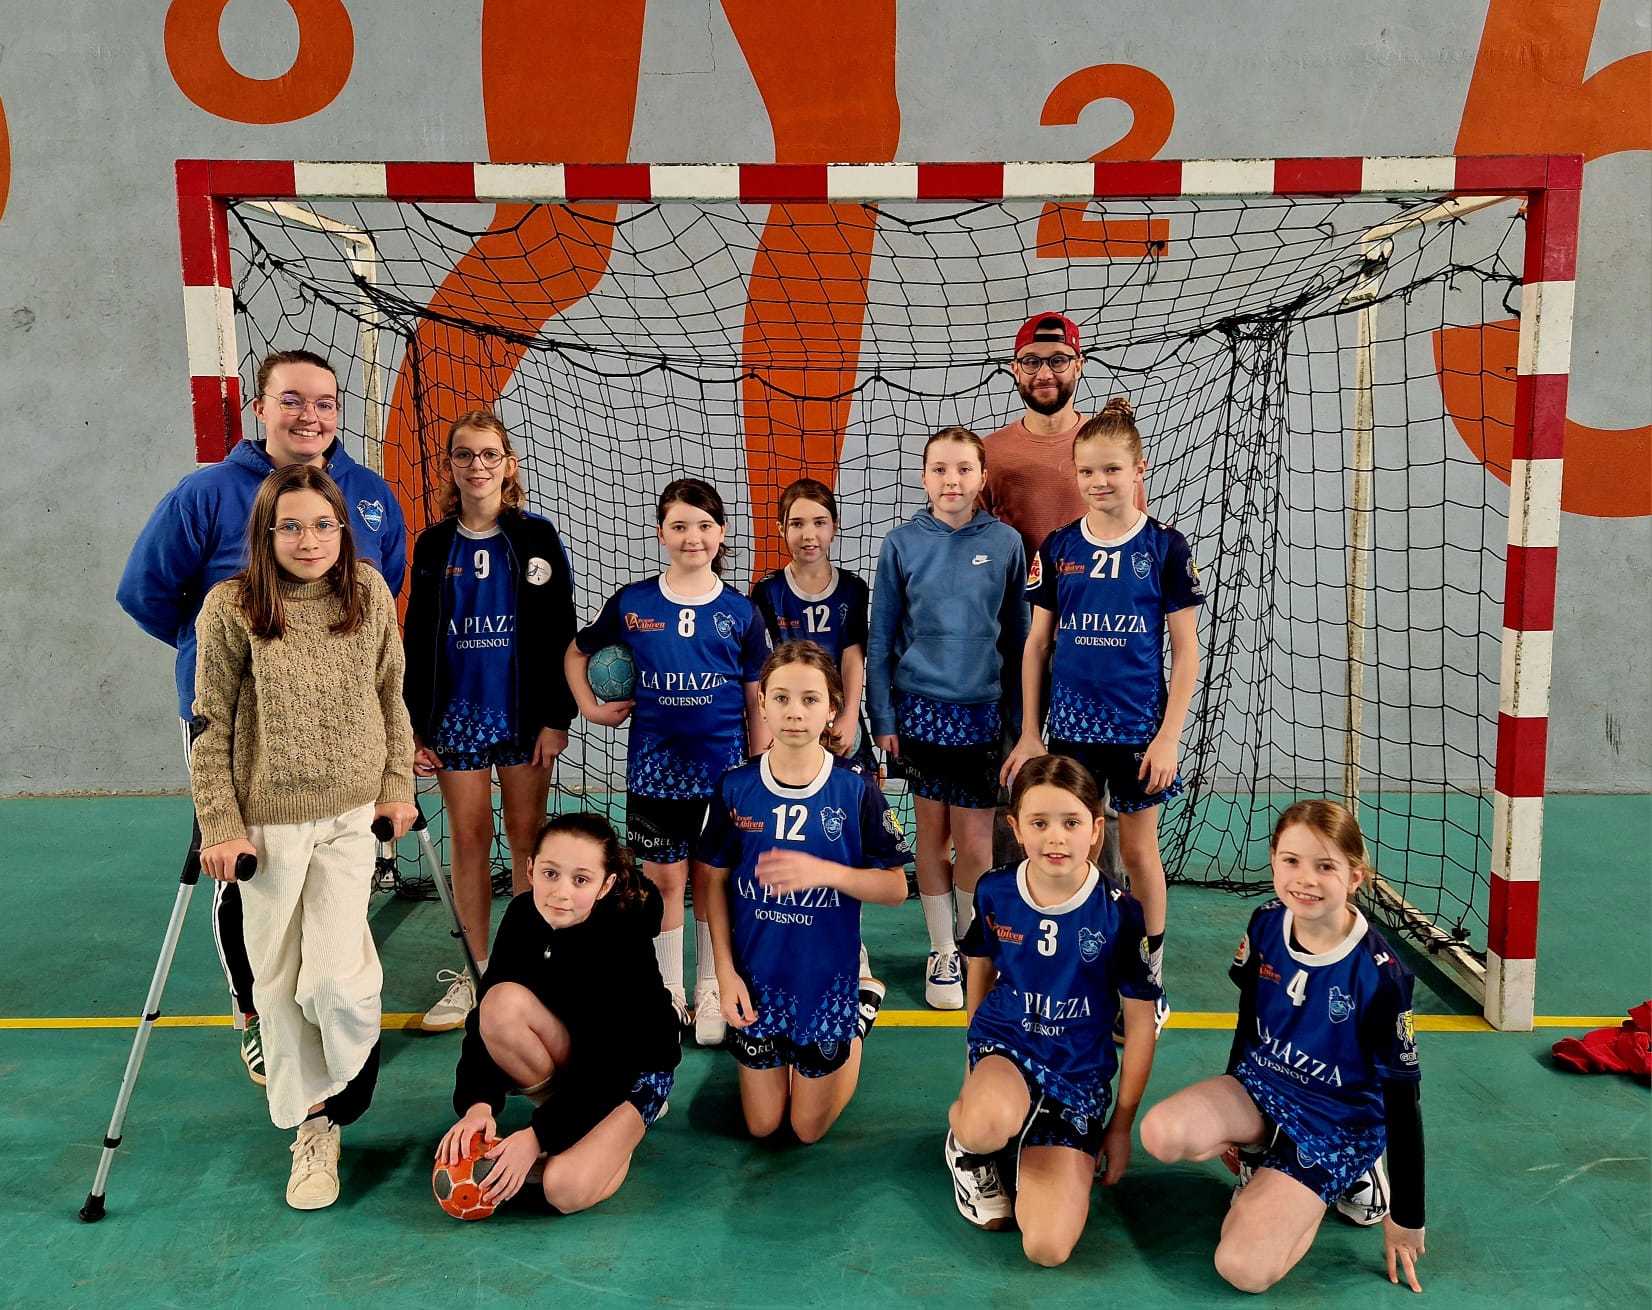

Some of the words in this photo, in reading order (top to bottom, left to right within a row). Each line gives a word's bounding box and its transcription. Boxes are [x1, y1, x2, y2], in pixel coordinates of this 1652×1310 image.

[1036, 63, 1175, 258] 2
[473, 549, 490, 579] 9
[1090, 549, 1121, 579] 21
[678, 608, 696, 638] 8
[802, 604, 832, 633] 12
[1059, 612, 1078, 630] LA
[1081, 613, 1148, 633] PIAZZA
[456, 637, 509, 650] GOUESNOU
[1074, 635, 1127, 647] GOUESNOU
[640, 670, 660, 690] LA
[658, 694, 713, 707] GOUESNOU
[772, 804, 808, 841] 12
[763, 882, 842, 908] PIAZZA
[755, 908, 815, 926] GOUESNOU
[1037, 919, 1059, 957] 3
[1286, 968, 1309, 1007] 4
[1023, 991, 1092, 1020] PIAZZA
[1270, 1038, 1343, 1087] IAZZA
